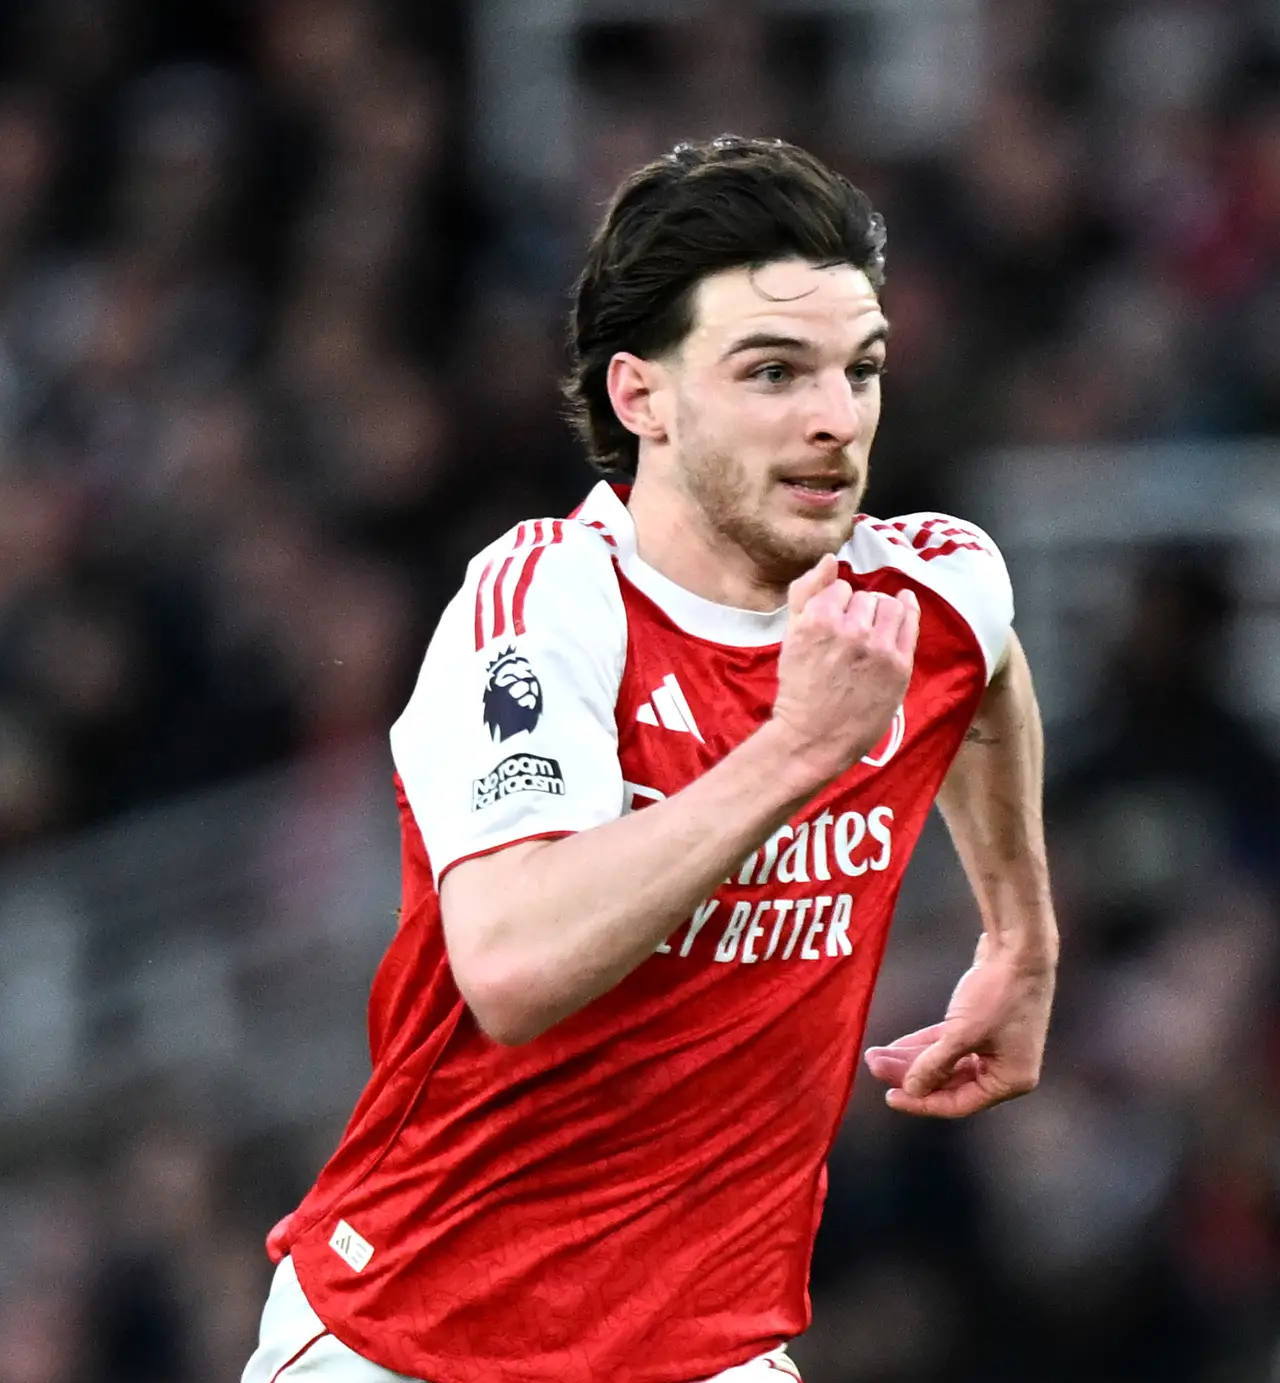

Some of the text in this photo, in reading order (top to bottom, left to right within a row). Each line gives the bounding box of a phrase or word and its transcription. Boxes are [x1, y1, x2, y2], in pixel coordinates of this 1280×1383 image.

[473, 757, 554, 798] No room
[499, 775, 565, 798] racism
[713, 892, 854, 964] BETTER
